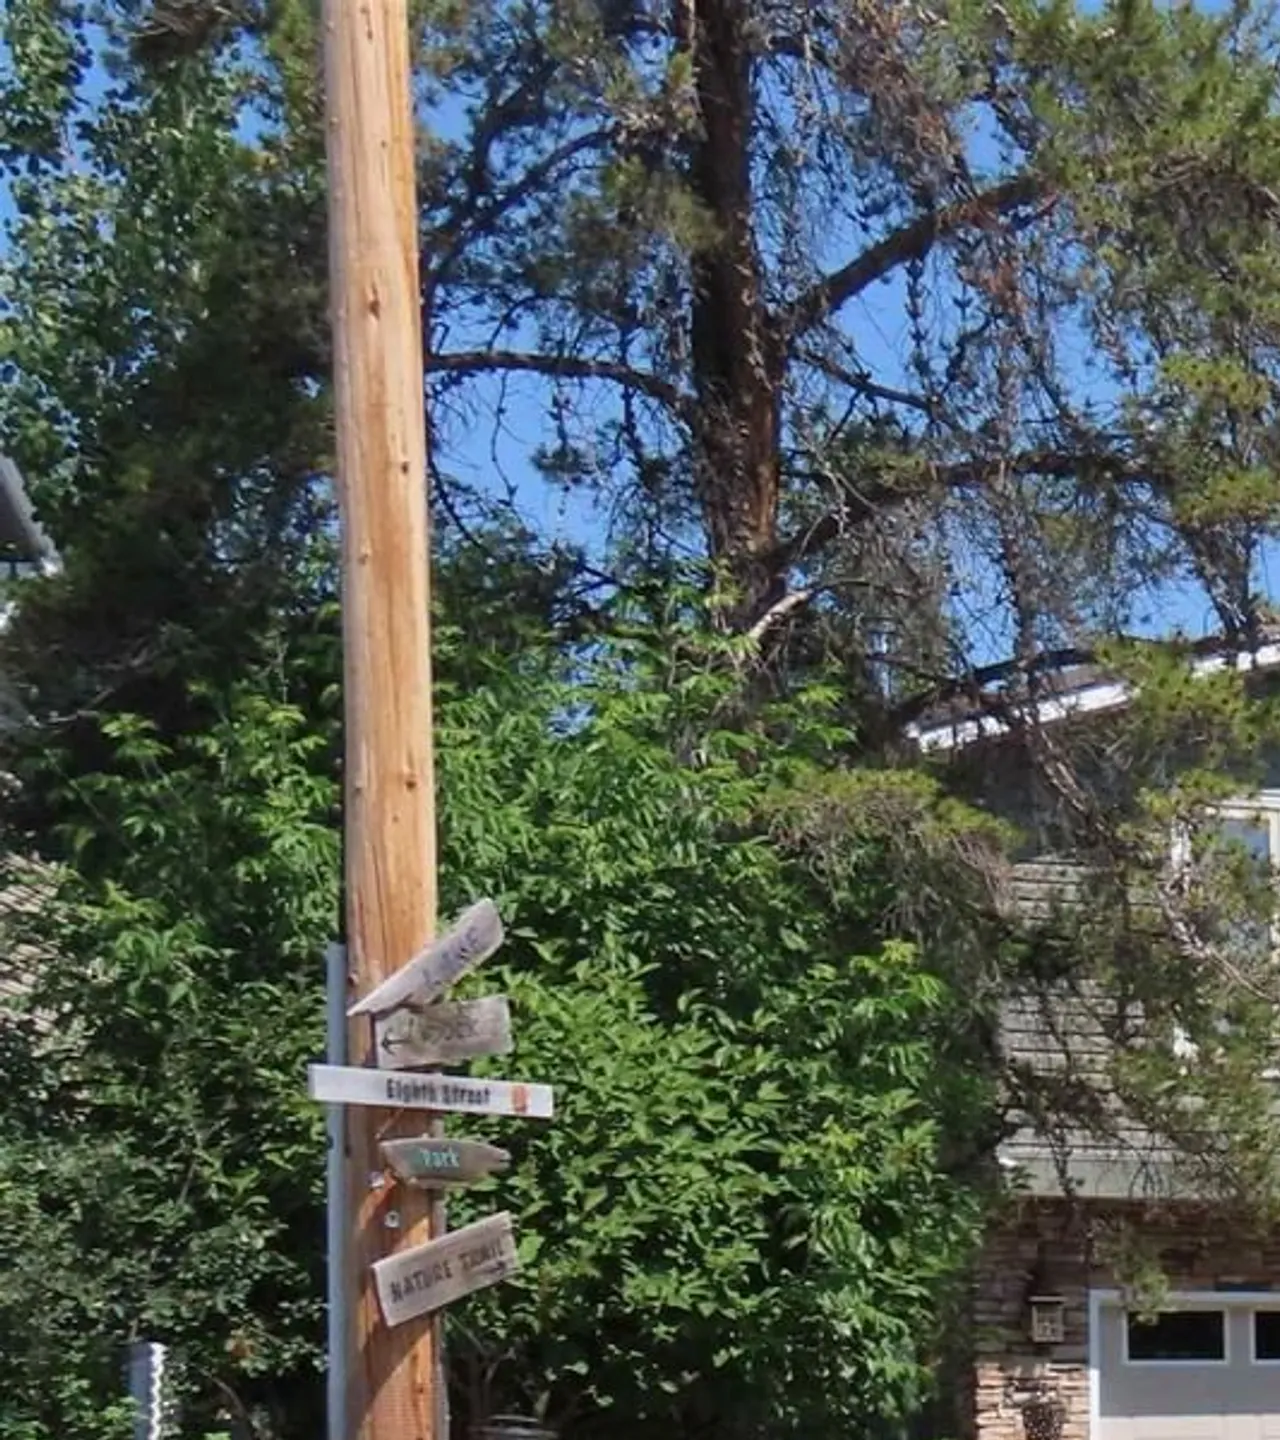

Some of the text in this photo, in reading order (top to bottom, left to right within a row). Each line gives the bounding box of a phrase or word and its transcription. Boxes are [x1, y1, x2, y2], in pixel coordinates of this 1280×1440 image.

[386, 1078, 491, 1106] Eighth Street
[419, 1147, 460, 1169] Park
[390, 1260, 453, 1304] NATURE
